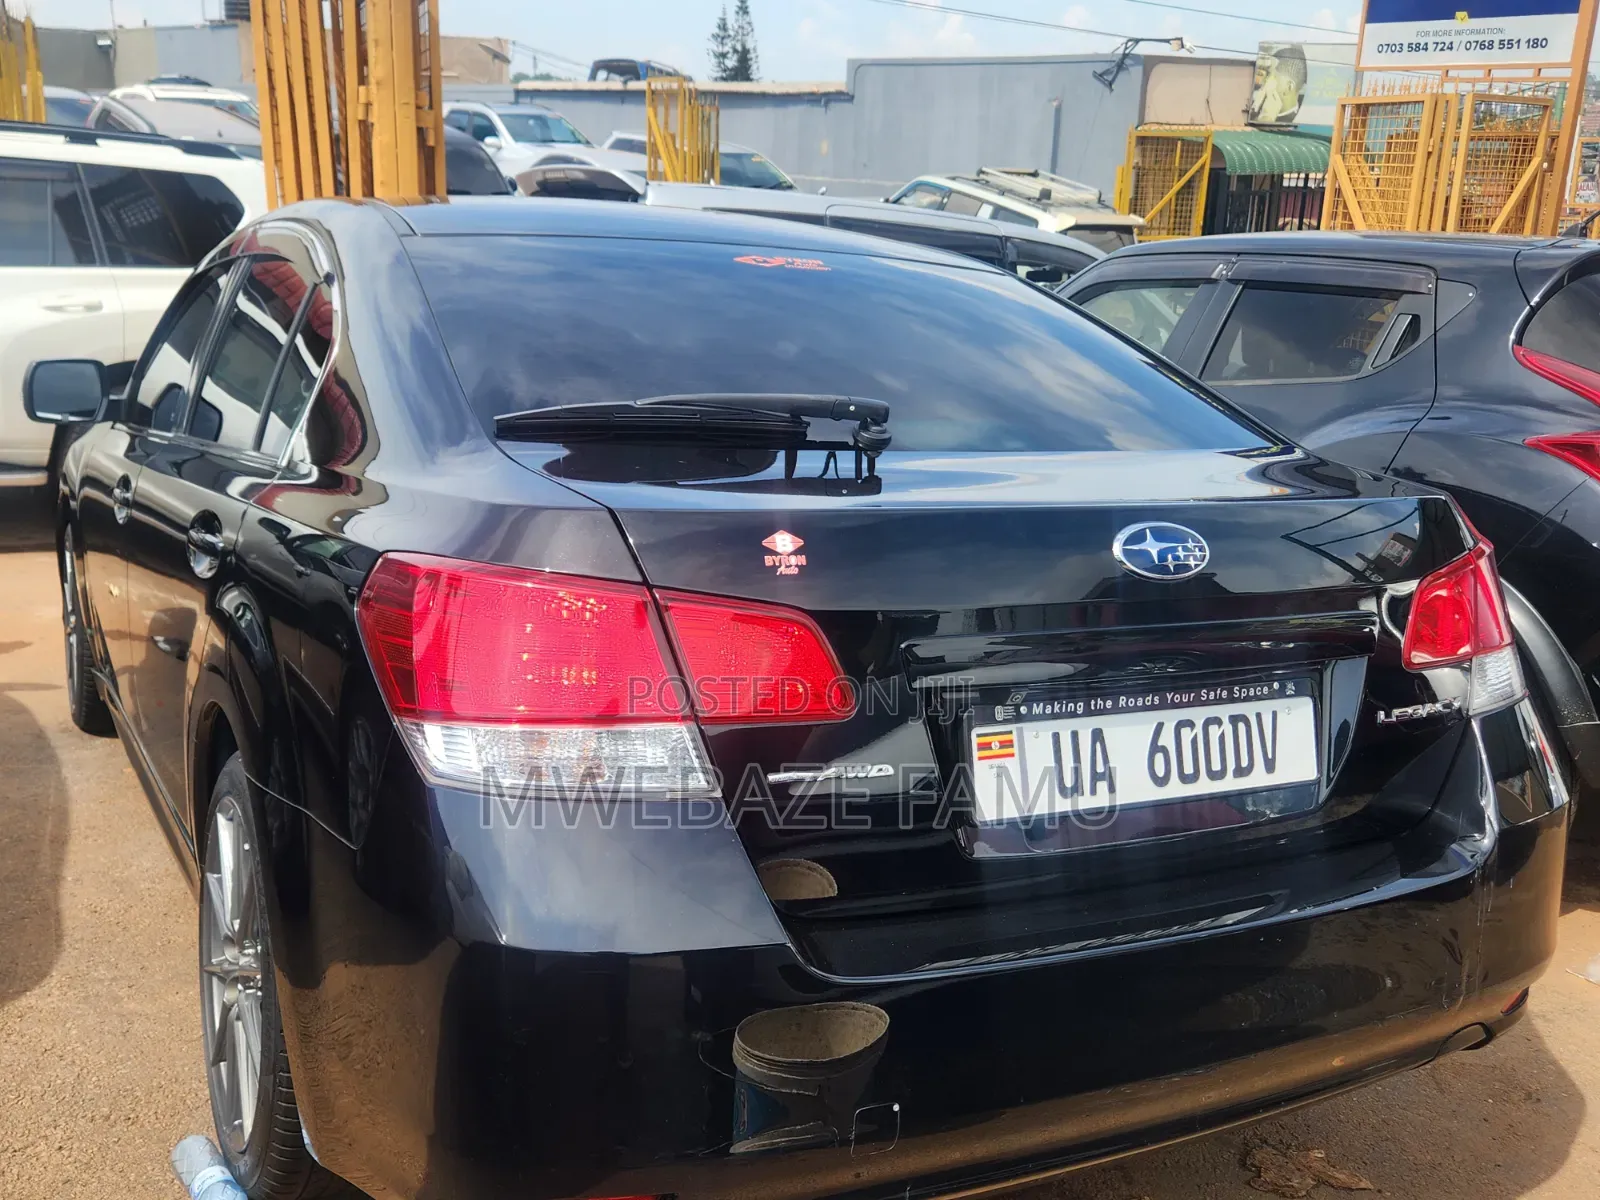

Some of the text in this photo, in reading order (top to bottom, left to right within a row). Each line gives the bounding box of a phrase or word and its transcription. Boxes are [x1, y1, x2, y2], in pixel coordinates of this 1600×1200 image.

[1416, 27, 1506, 38] FOR MORE INFORMATION:
[1377, 43, 1404, 54] 0703
[1407, 42, 1429, 52] 584
[1433, 41, 1454, 52] 724
[1464, 40, 1495, 51] 0768
[1498, 38, 1521, 50] 551
[1525, 37, 1549, 49] 180
[764, 555, 807, 567] BYRON
[1032, 702, 1084, 715] Making
[1090, 697, 1113, 711] the
[1118, 693, 1160, 708] Roads
[1166, 691, 1195, 704] Your
[1200, 687, 1228, 701] Safe
[1233, 684, 1269, 699] Space
[1051, 710, 1279, 800] UA 600DV
